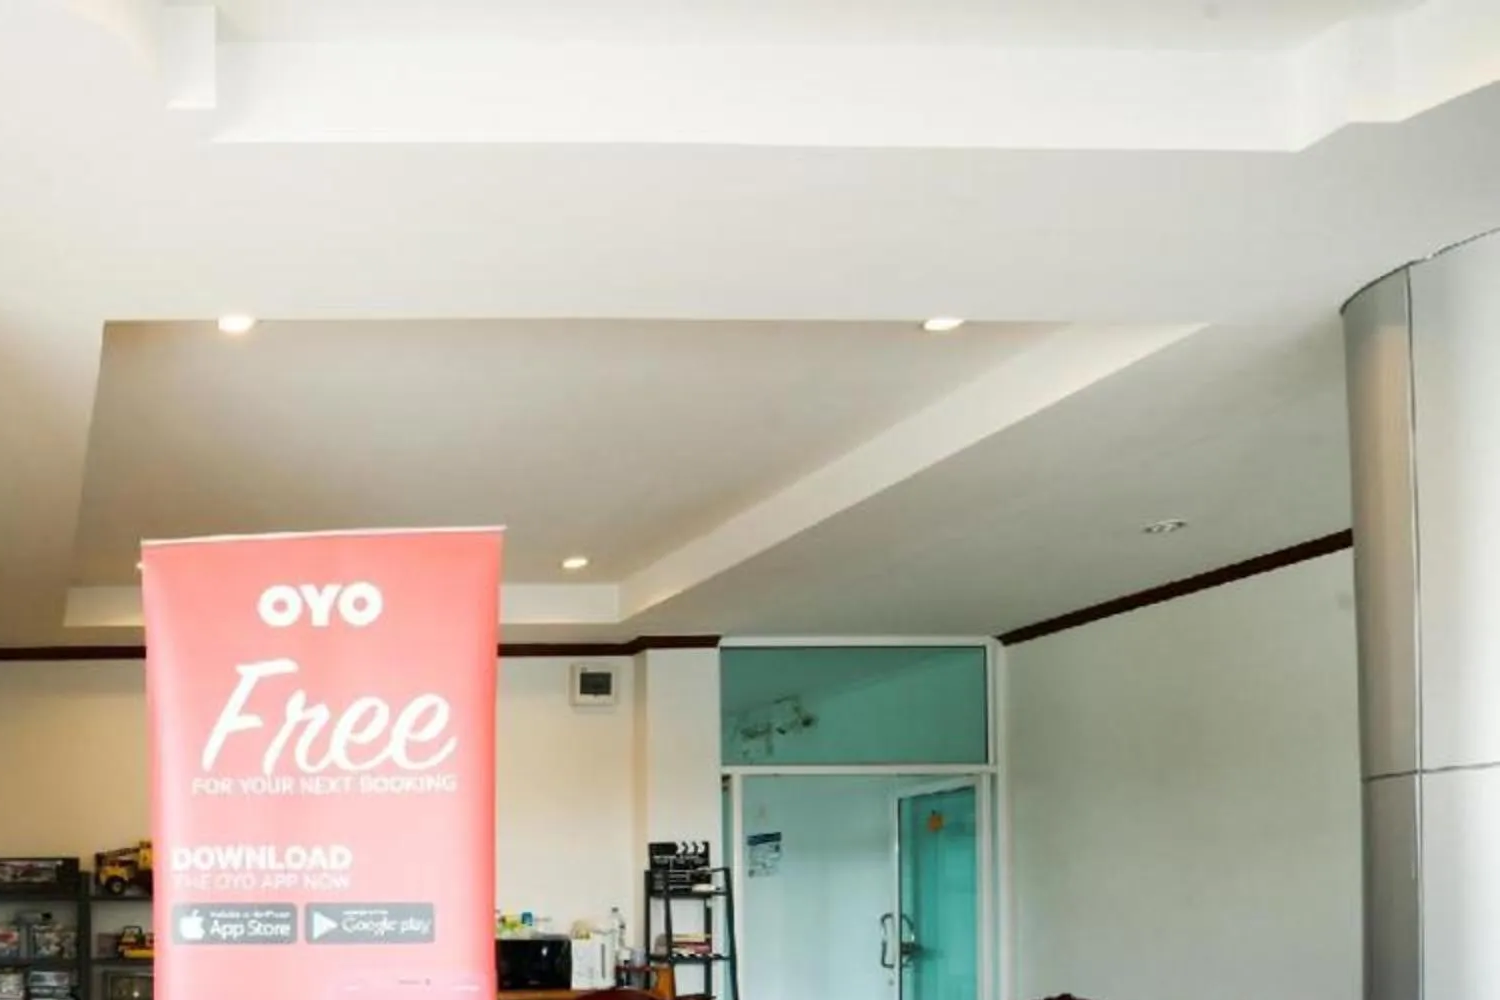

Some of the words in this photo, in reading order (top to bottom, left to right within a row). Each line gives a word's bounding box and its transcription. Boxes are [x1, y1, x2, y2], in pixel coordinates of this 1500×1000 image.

[258, 581, 383, 628] OYO
[202, 658, 458, 775] Free
[193, 777, 233, 796] FOR
[238, 776, 293, 795] YOUR
[300, 776, 351, 794] NEXT
[360, 774, 457, 793] BOOKING
[172, 845, 353, 872] DOWNLOAD
[174, 873, 210, 891] THE
[214, 873, 256, 890] OYO
[261, 873, 298, 890] APP
[303, 872, 350, 890] NOW
[210, 921, 245, 939] App
[249, 919, 291, 937] Store
[341, 917, 395, 939] Google
[401, 916, 431, 935] play
